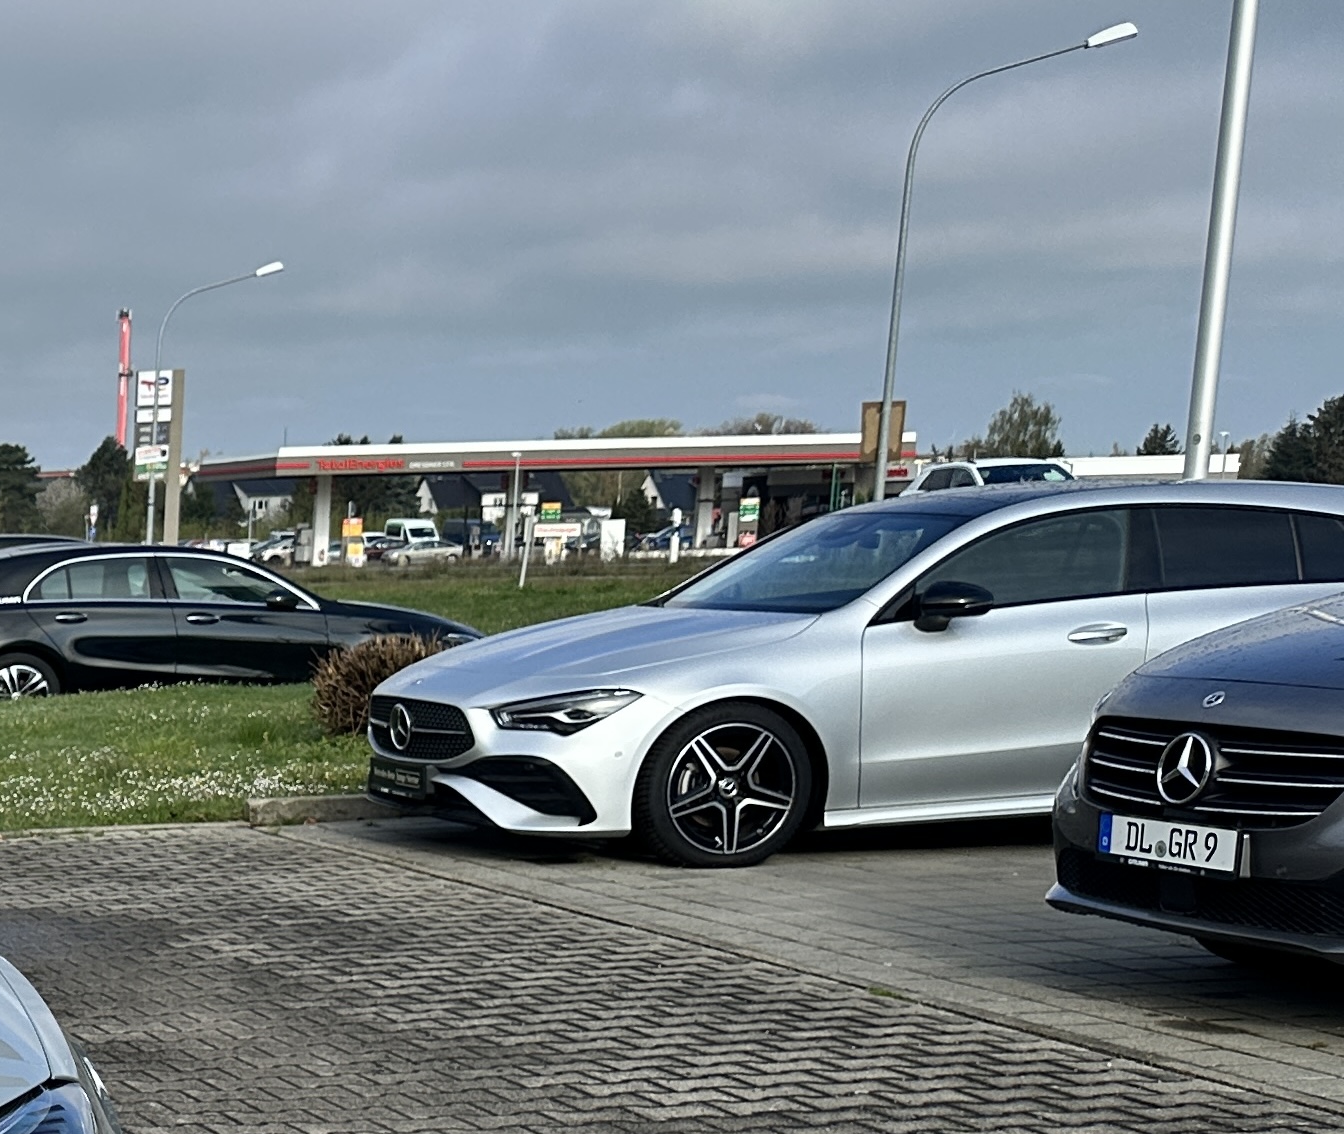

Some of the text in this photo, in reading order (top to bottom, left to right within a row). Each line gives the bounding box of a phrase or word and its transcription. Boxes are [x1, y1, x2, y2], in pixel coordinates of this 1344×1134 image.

[317, 458, 405, 472] TotalEnergies
[1125, 821, 1218, 862] DL GR 9
